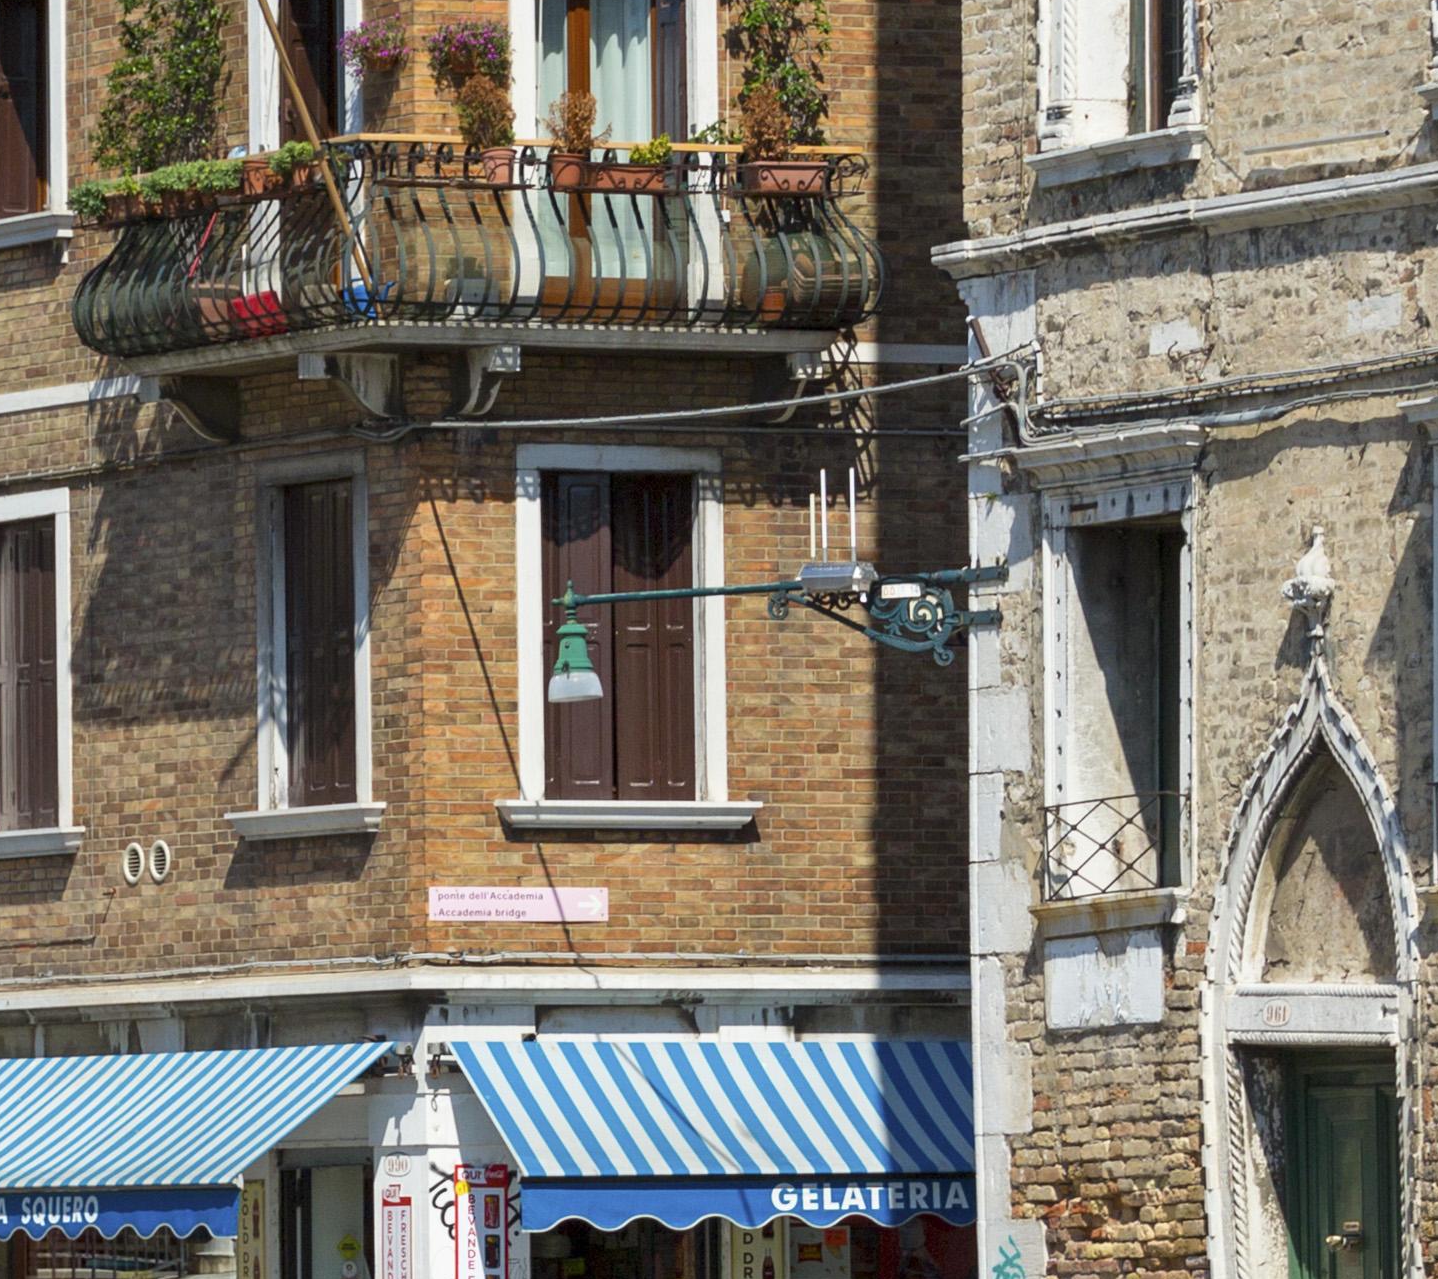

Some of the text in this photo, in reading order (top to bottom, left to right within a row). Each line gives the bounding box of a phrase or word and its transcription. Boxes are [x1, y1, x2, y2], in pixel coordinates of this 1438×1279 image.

[437, 891, 544, 902] ponte dell'Accademia
[438, 908, 527, 920] Accademia bridge
[387, 1158, 409, 1171] 990
[21, 1196, 99, 1226] SQUERO
[771, 1182, 970, 1212] GELATERIA
[241, 1189, 251, 1244] COLD
[467, 1194, 476, 1270] BEVANDE
